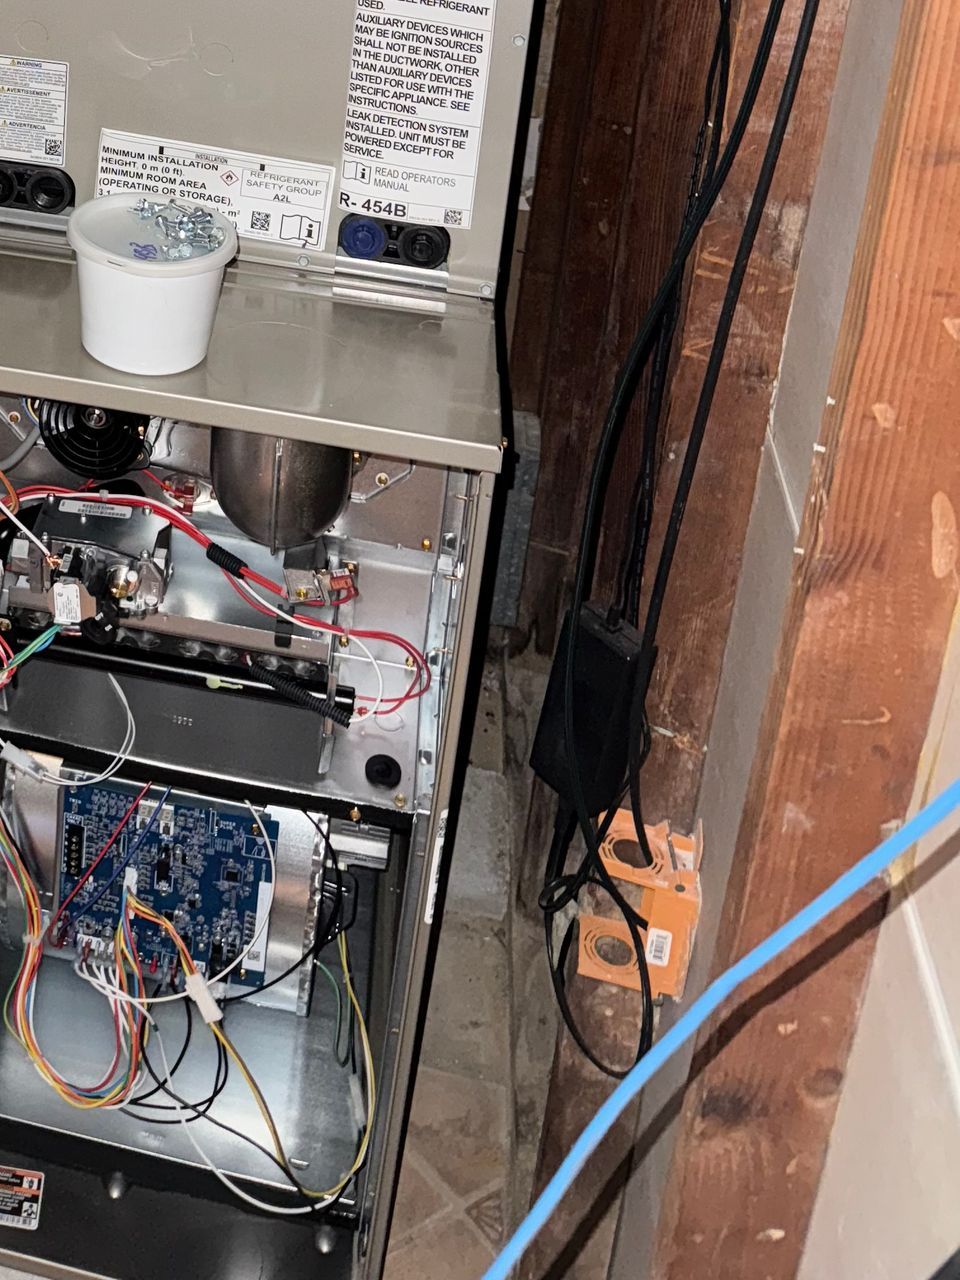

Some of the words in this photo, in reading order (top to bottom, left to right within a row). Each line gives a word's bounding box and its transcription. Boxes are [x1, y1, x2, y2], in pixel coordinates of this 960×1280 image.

[356, 12, 405, 29] AUXILIARY
[407, 21, 448, 35] DEVICES
[450, 28, 484, 42] WHICH
[355, 24, 375, 36] MAY
[376, 28, 390, 38] BE
[391, 31, 432, 45] IGNITION
[434, 38, 483, 53] SOURCES
[354, 36, 386, 49] SHALL
[386, 42, 407, 53] NOT
[408, 45, 422, 55] BE
[423, 47, 477, 64] INSTALLED
[16, 60, 42, 68] WARNING
[352, 48, 362, 56] IN
[364, 50, 382, 61] THE
[445, 64, 480, 77] OTHER
[352, 59, 377, 72] THAN
[378, 65, 428, 81] AUXILIARY
[429, 73, 472, 87] DEVICES
[6, 88, 51, 96] AVERTISSEMENT
[349, 83, 390, 98] SPECIFIC
[391, 91, 448, 108] APPLIANCE.
[450, 101, 470, 111] SEE
[350, 72, 382, 85] LISTED
[384, 78, 404, 89] FOR
[406, 81, 425, 92] USE
[427, 85, 452, 97] WITH
[454, 89, 474, 100] THE
[348, 94, 418, 115] INSTRUCTIONS.
[8, 121, 46, 130] ADVERTENCIA
[347, 108, 371, 121] LEAK
[372, 113, 426, 132] DETECTION
[428, 124, 469, 138] SYSTEM
[345, 131, 392, 149] POWERED
[393, 141, 432, 156] EXCEPT
[433, 148, 454, 159] FOR
[346, 120, 396, 139] INSTALLED.
[399, 130, 421, 142] UNIT
[422, 135, 450, 146] MUST
[452, 140, 466, 150] BE
[102, 145, 145, 160] MINIMUM
[147, 153, 219, 172] INSTALLATION
[194, 153, 228, 164] INSTALLATION
[344, 142, 384, 159] SERVICE.
[100, 166, 144, 181] MINIMUM
[146, 173, 177, 186] ROOM
[179, 179, 207, 190] AREA
[160, 165, 172, 174] (0
[250, 170, 320, 187] REFRIGERANT
[375, 166, 399, 179] READ
[401, 172, 456, 187] OPERATORS
[98, 178, 159, 196] (OPERATING
[162, 187, 177, 196] OR
[246, 179, 284, 192] SAFETY
[286, 185, 322, 197] GROUP
[374, 178, 410, 192] MANUAL
[272, 193, 291, 203] A2L
[340, 192, 357, 208] R-
[361, 199, 407, 218] 454B
